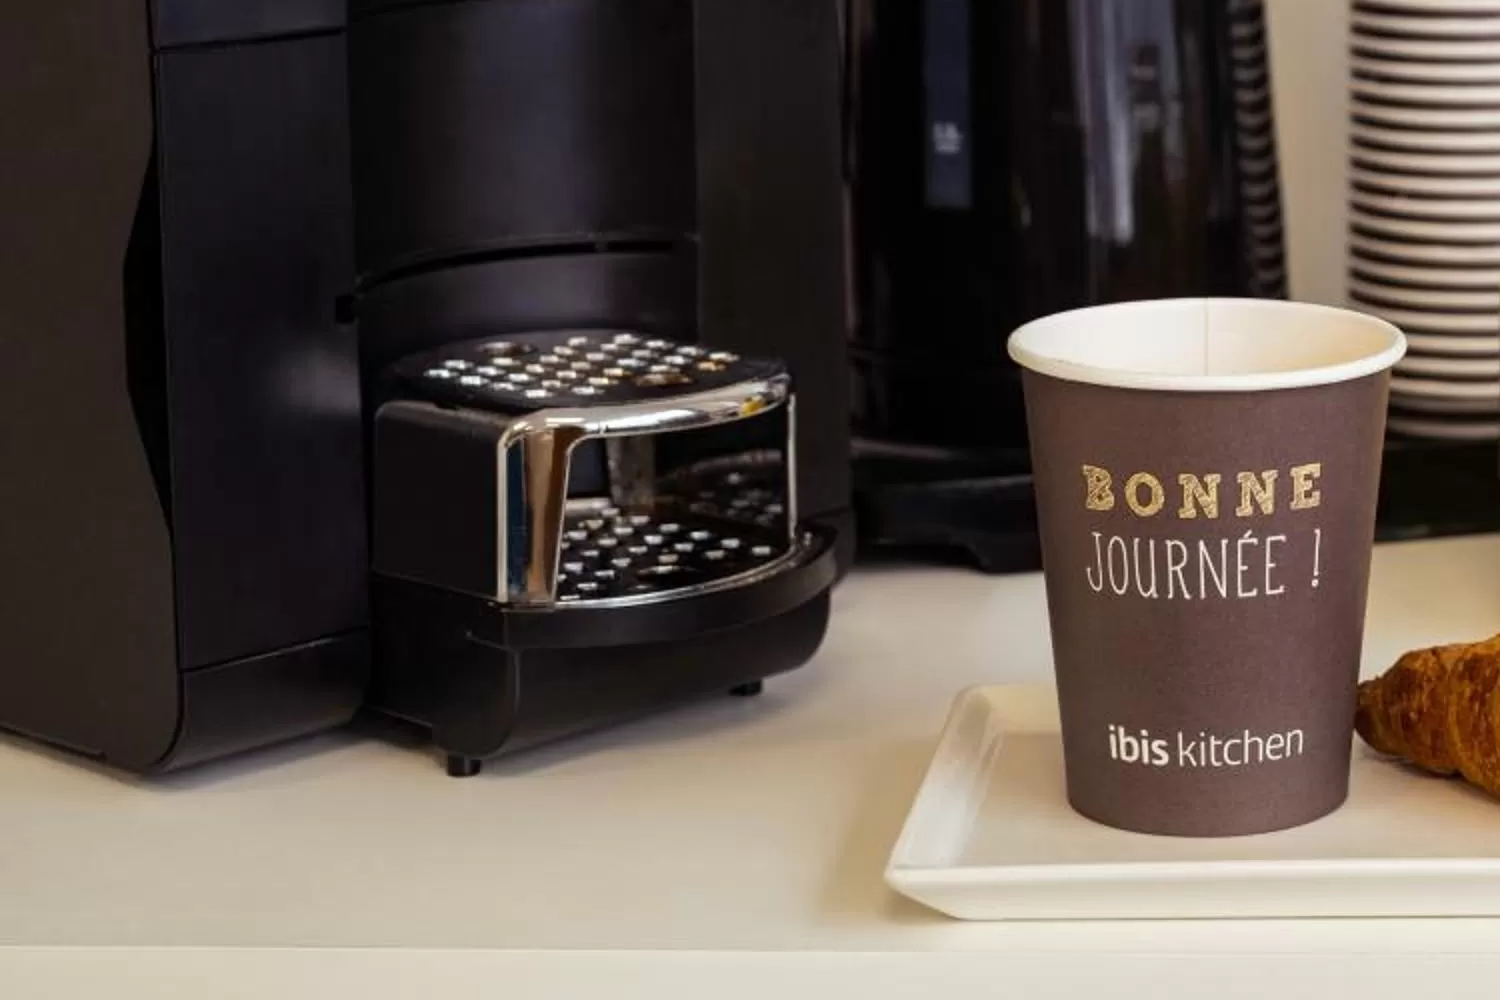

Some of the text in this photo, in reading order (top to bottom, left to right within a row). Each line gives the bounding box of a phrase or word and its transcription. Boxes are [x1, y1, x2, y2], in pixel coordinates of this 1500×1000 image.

[1081, 463, 1322, 520] BONNE
[1085, 528, 1323, 600] JOURNÉE !
[1108, 725, 1304, 768] ibis kitchen
